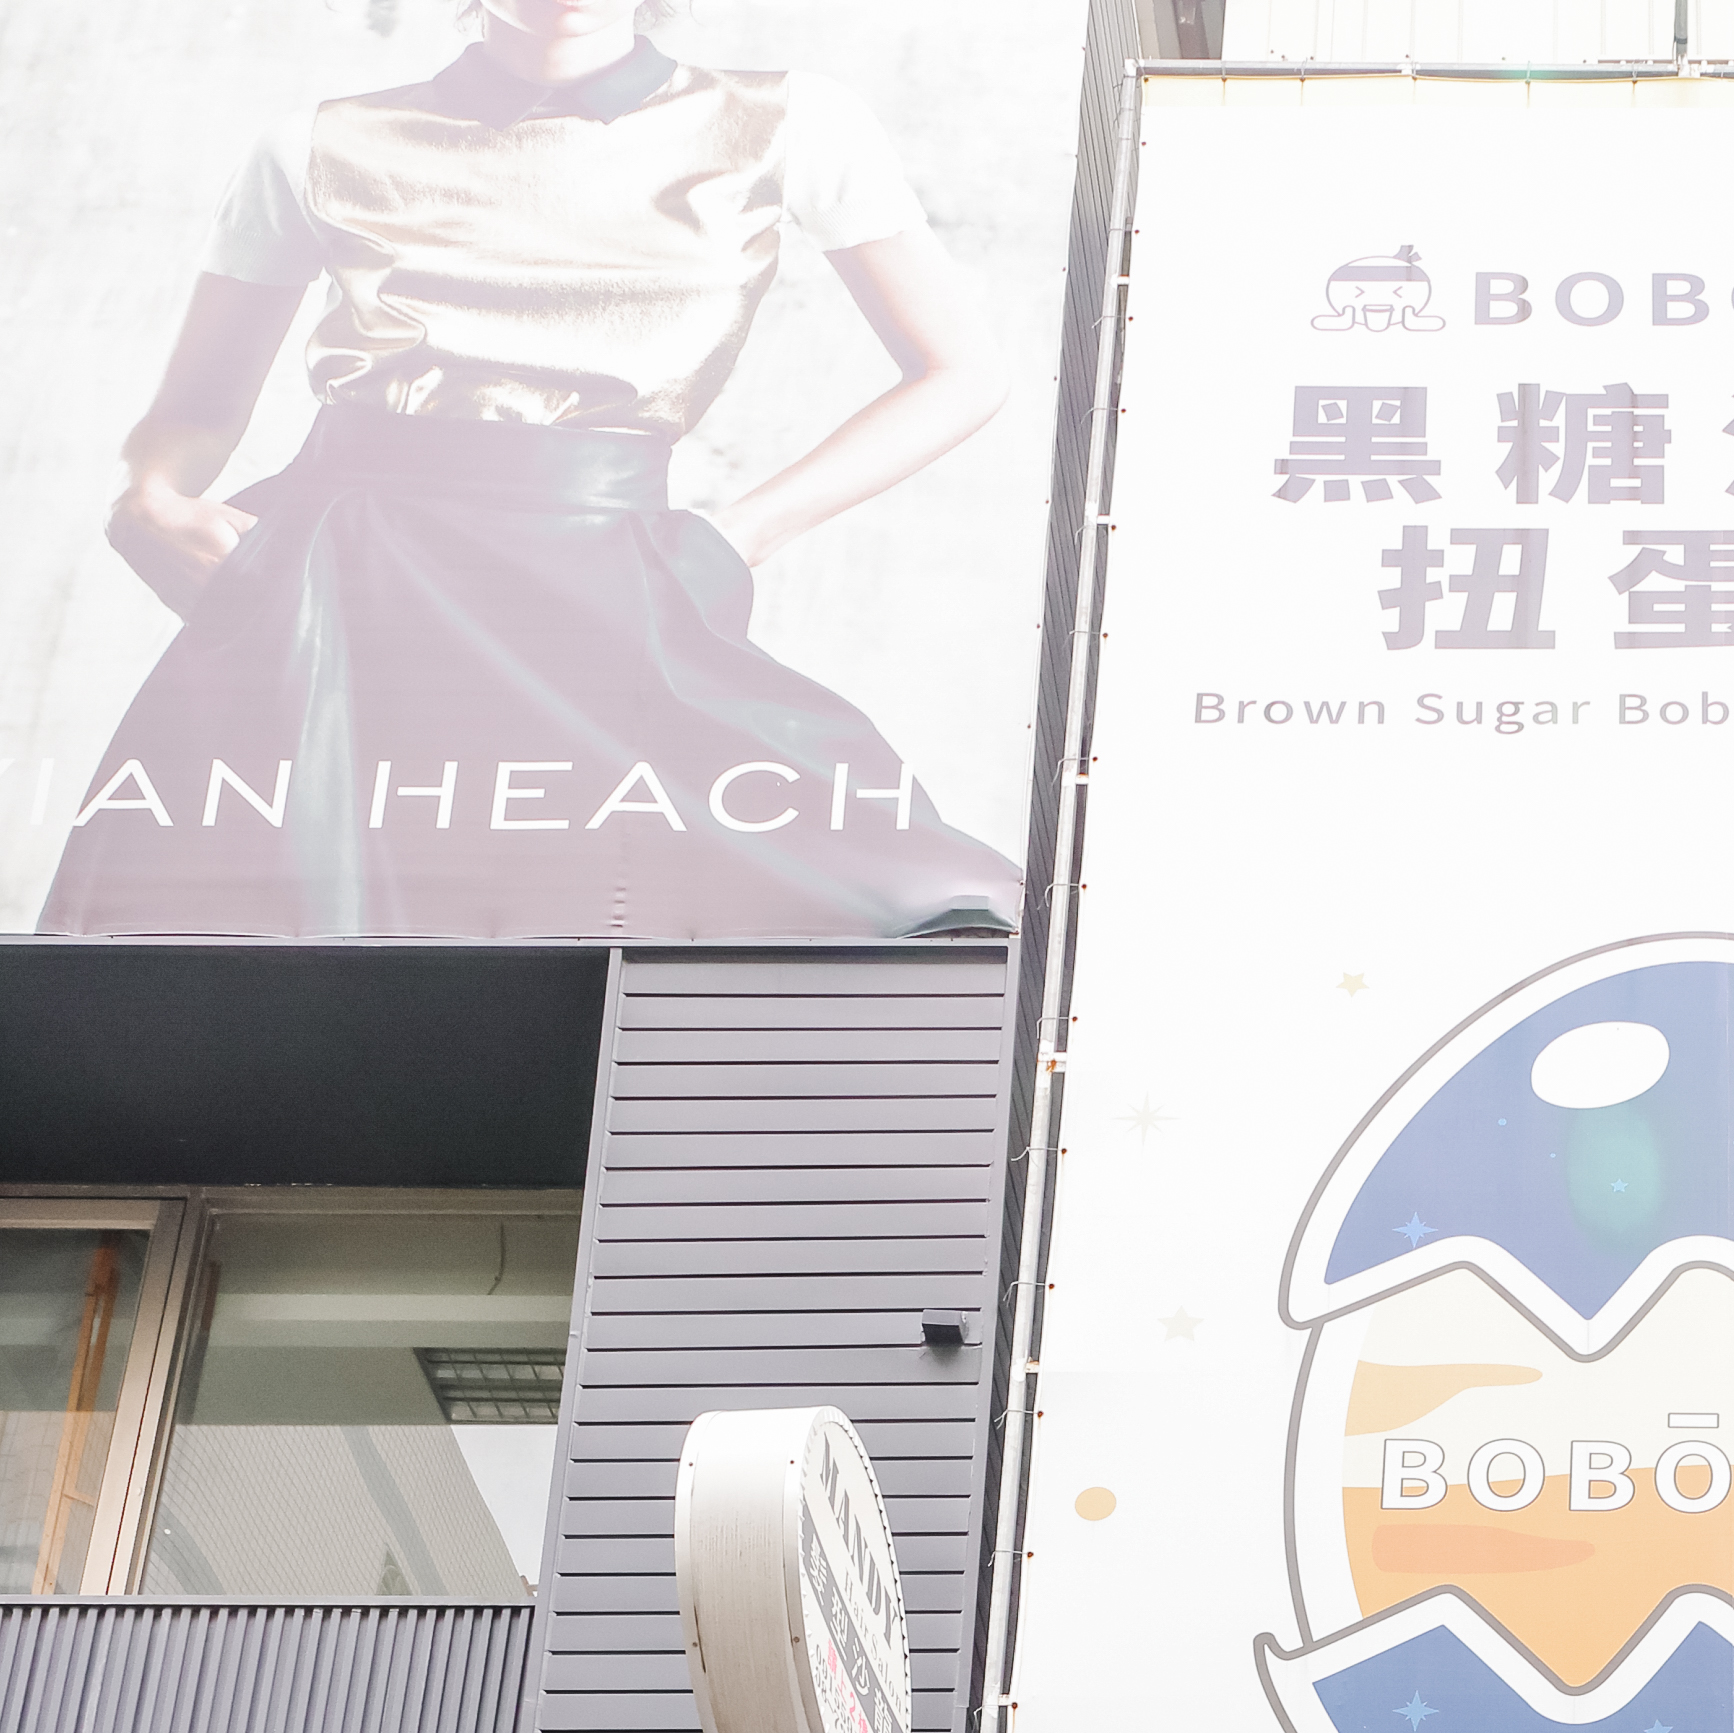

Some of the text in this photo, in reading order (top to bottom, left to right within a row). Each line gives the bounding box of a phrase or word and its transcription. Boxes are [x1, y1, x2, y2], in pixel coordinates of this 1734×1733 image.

[1193, 691, 1387, 726] Brown
[1413, 690, 1592, 736] Sugar
[369, 760, 915, 833] HEACH
[819, 1431, 899, 1650] MANDY
[845, 1567, 902, 1716] Hair Salon
